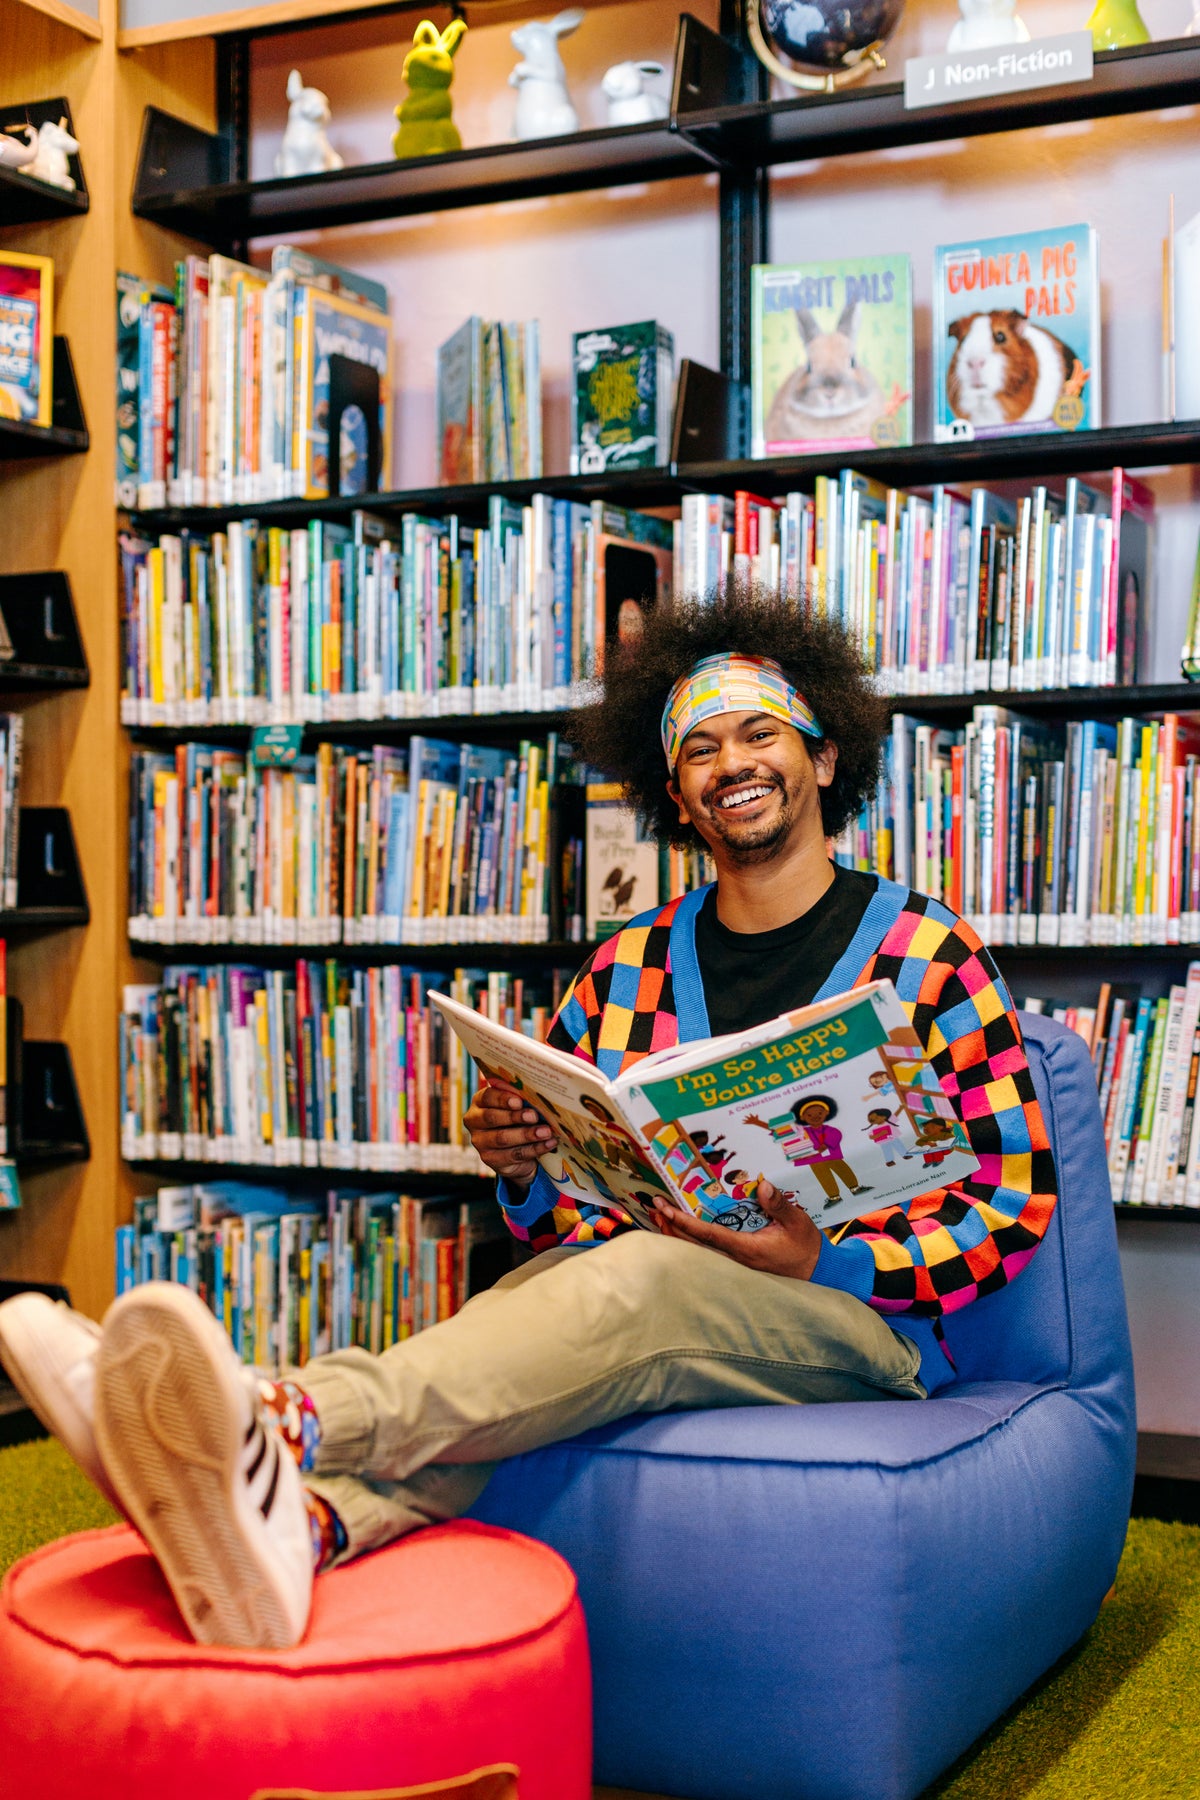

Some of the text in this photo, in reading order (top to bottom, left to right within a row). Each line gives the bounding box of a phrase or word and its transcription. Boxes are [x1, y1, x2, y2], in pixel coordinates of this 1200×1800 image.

[923, 49, 1073, 90] J Non-Fiction
[947, 241, 1077, 294] GUINEA PIG
[845, 271, 896, 305] PALS
[1024, 281, 1077, 317] PALS
[673, 1018, 849, 1094] I'm So Happy
[698, 1047, 848, 1107] You're Here
[735, 1093, 781, 1112] Celebration
[782, 1088, 791, 1096] of
[792, 1079, 823, 1092] Library
[824, 1072, 839, 1082] Joy
[901, 1178, 930, 1191] Lorraine
[930, 1170, 947, 1180] Nam
